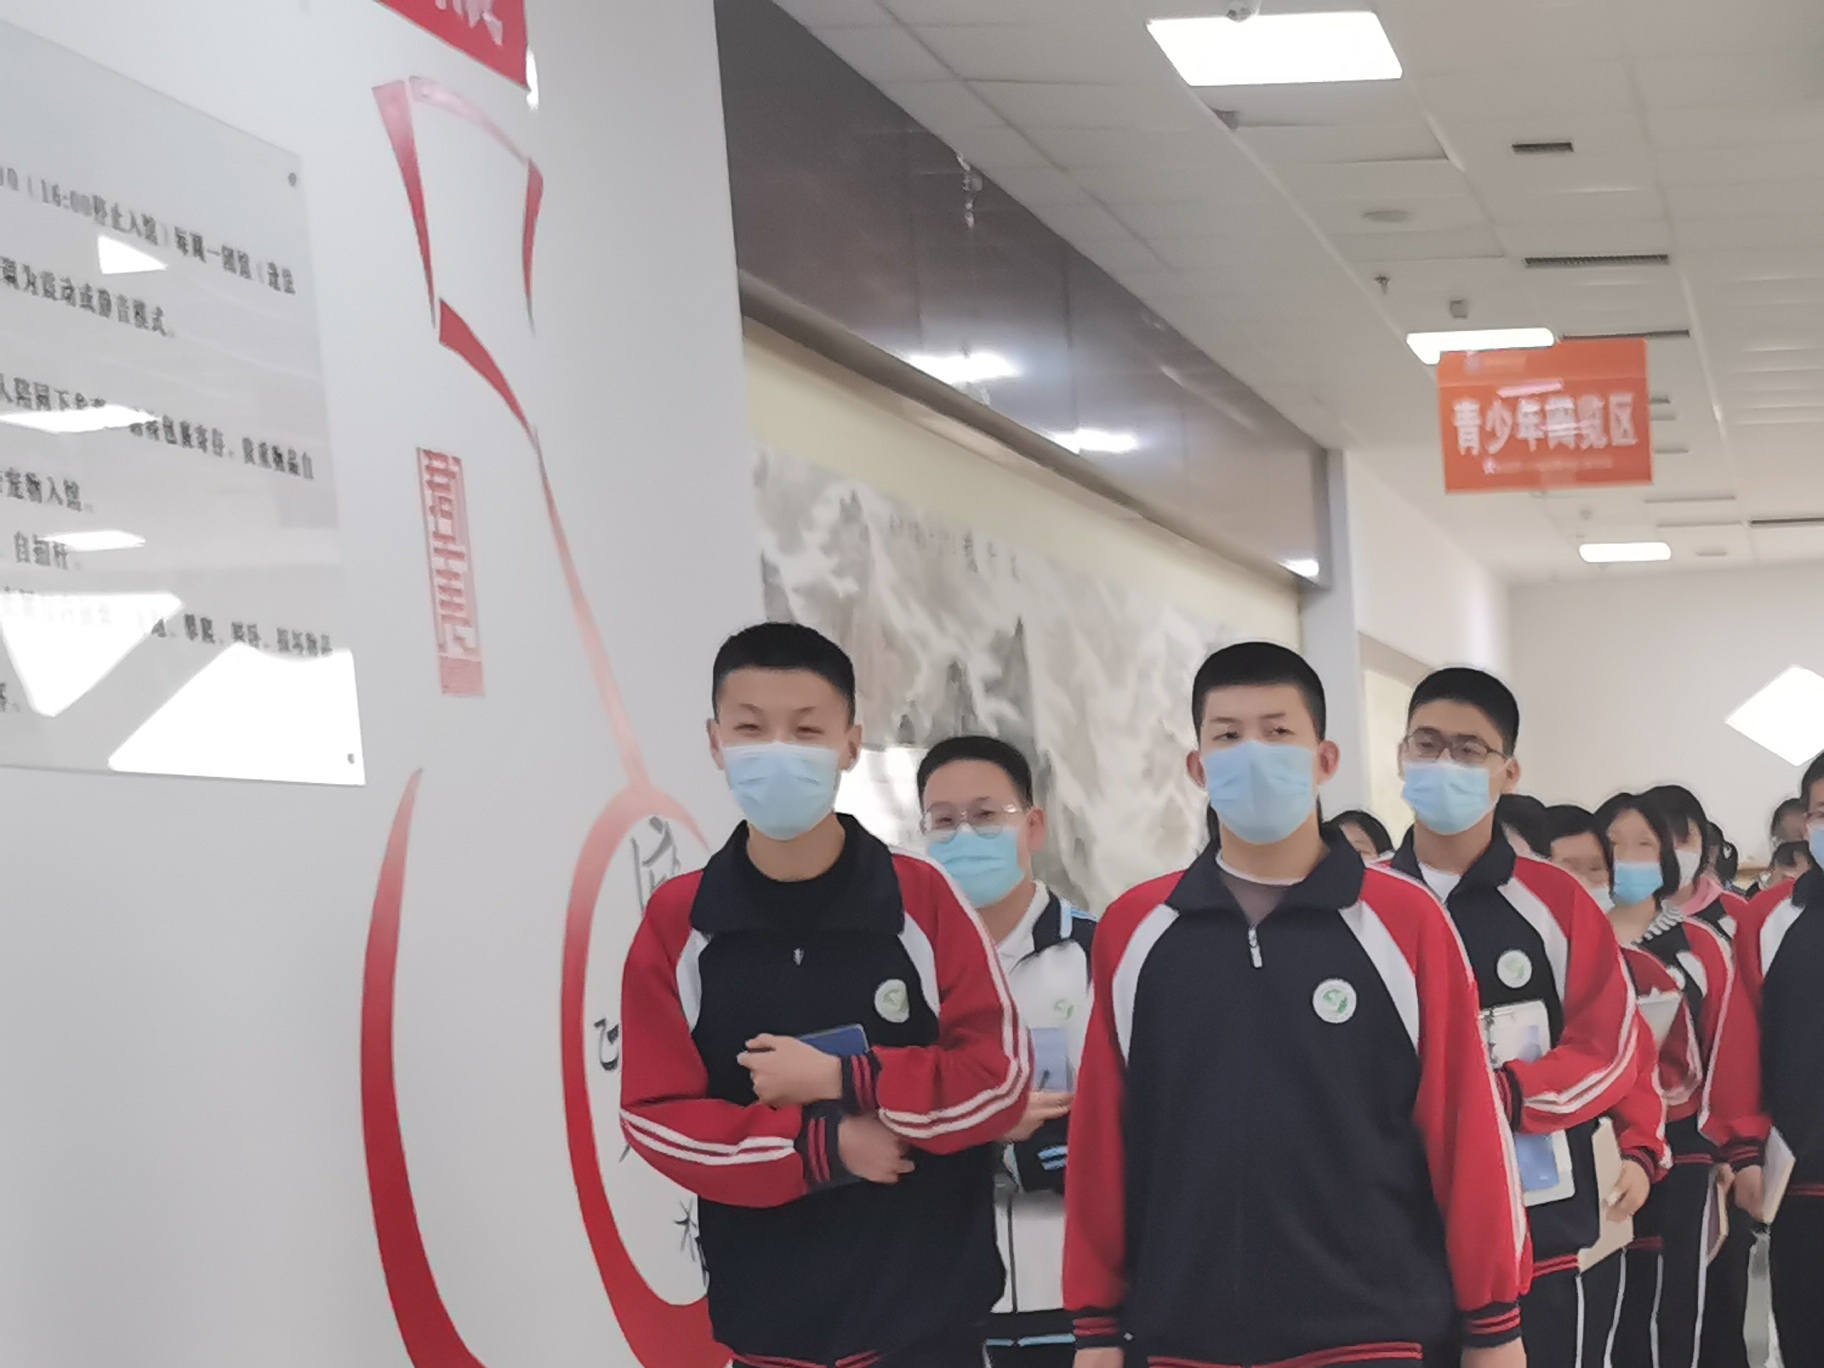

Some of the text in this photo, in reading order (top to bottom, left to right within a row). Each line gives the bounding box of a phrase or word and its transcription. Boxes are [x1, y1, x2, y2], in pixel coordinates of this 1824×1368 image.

[1453, 391, 1638, 456] 青少年阅览区
